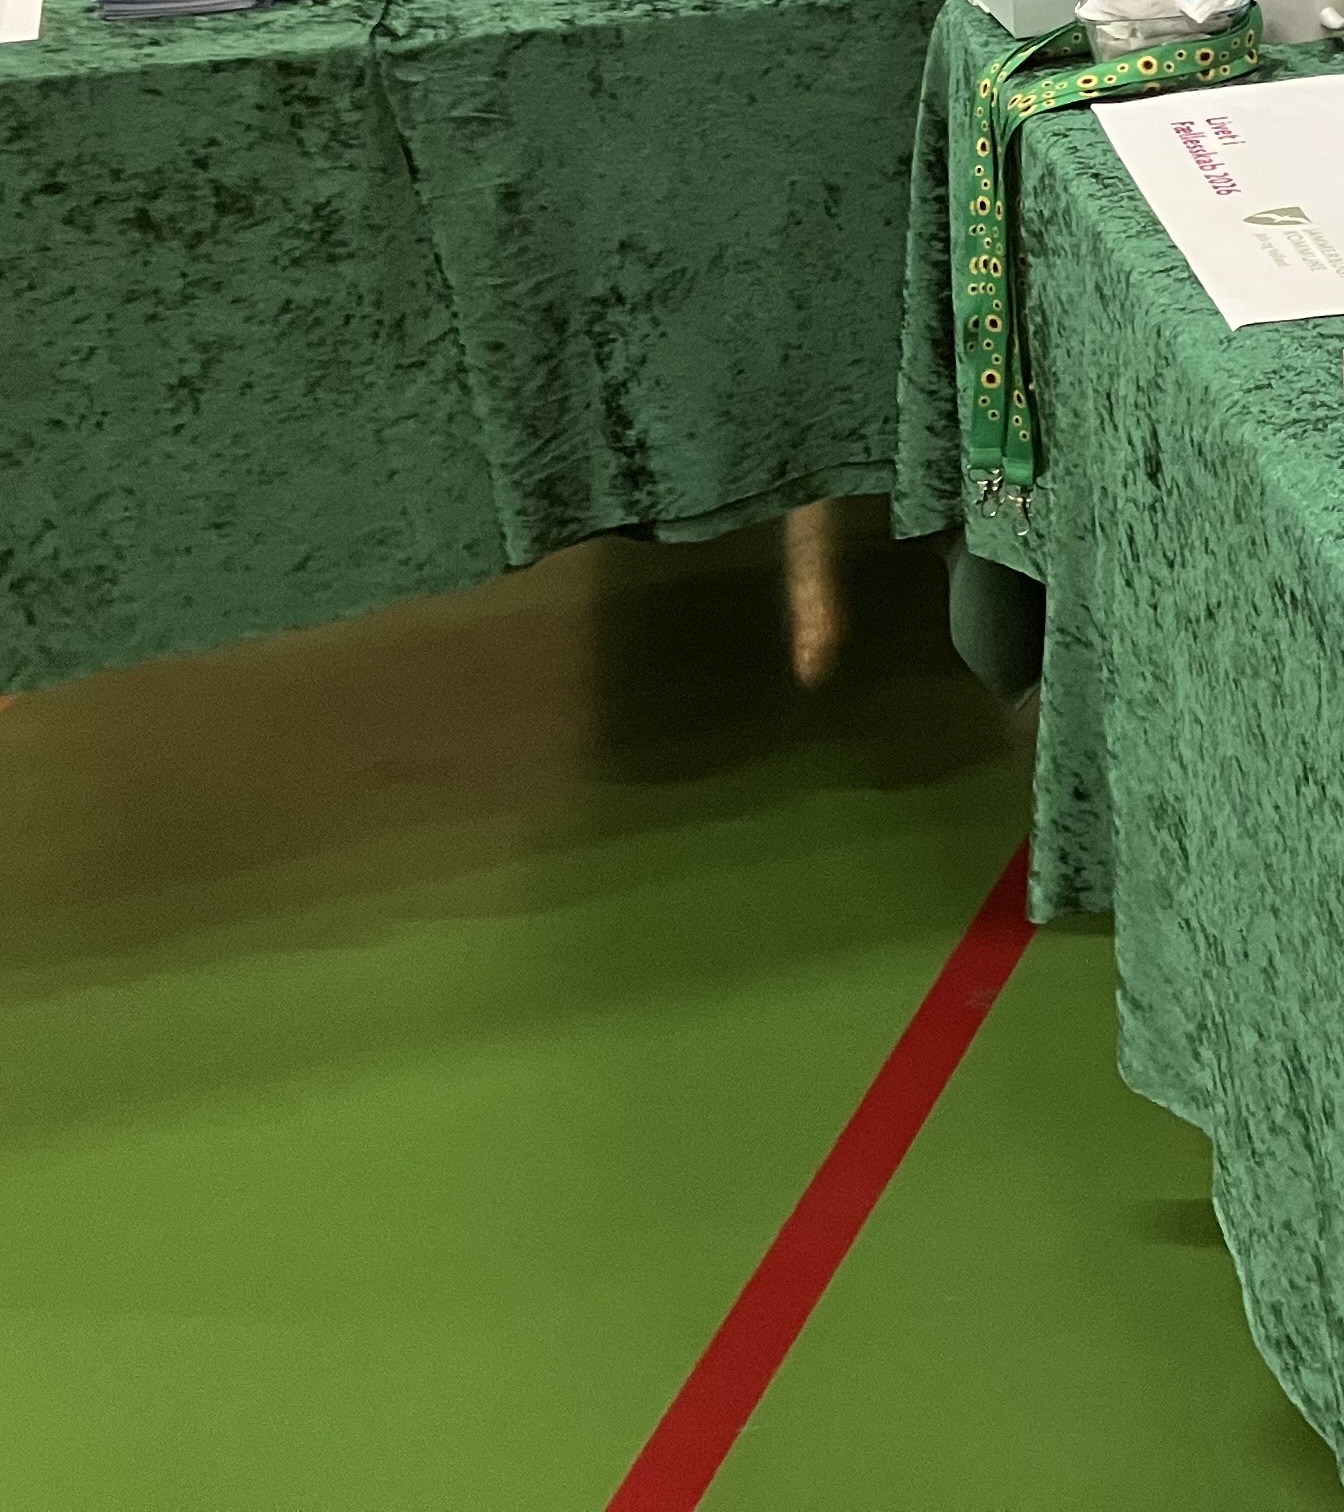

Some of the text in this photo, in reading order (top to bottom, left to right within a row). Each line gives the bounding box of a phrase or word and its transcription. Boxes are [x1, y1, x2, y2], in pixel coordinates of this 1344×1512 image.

[1205, 115, 1239, 140] Livet
[1169, 120, 1242, 196] Fællesskab 2026
